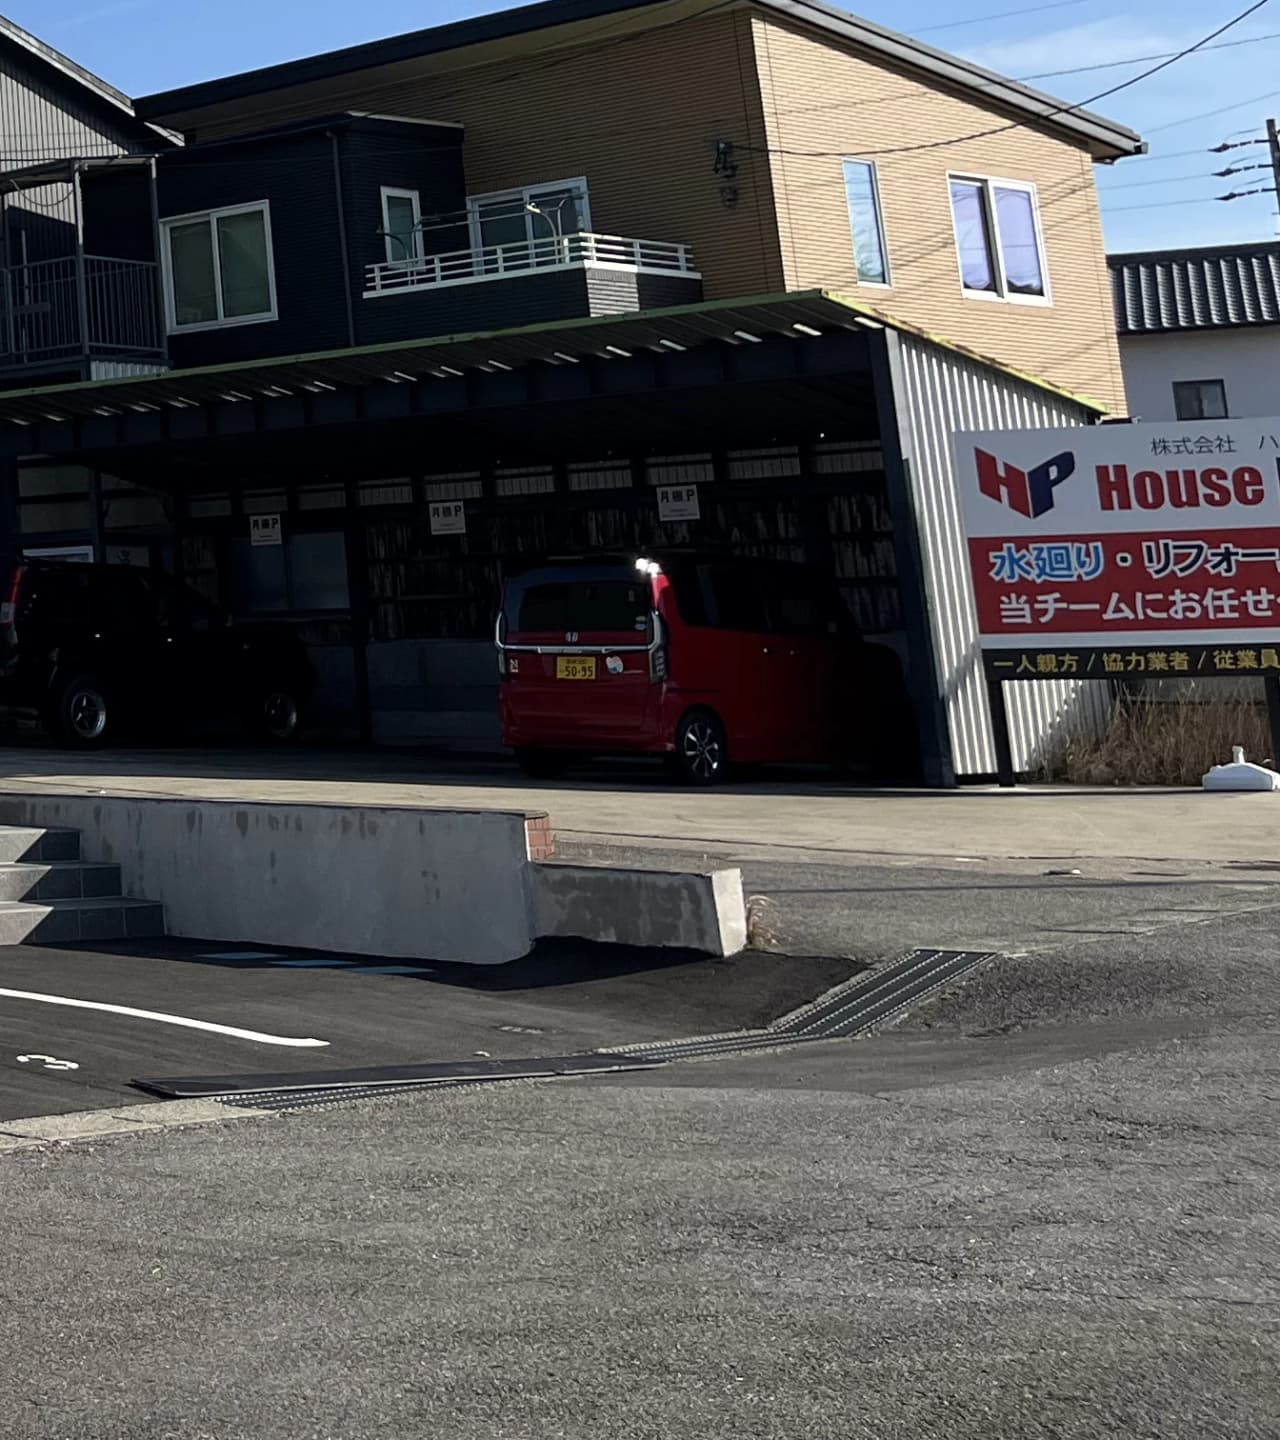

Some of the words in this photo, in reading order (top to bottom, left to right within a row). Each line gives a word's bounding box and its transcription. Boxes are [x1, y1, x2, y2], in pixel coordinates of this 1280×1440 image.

[1151, 434, 1237, 456] 株式会社
[974, 446, 1076, 520] HP
[1095, 464, 1265, 511] House
[990, 539, 1280, 583] 水廻り・リフォー
[999, 587, 1280, 625] 当チームにお任せ
